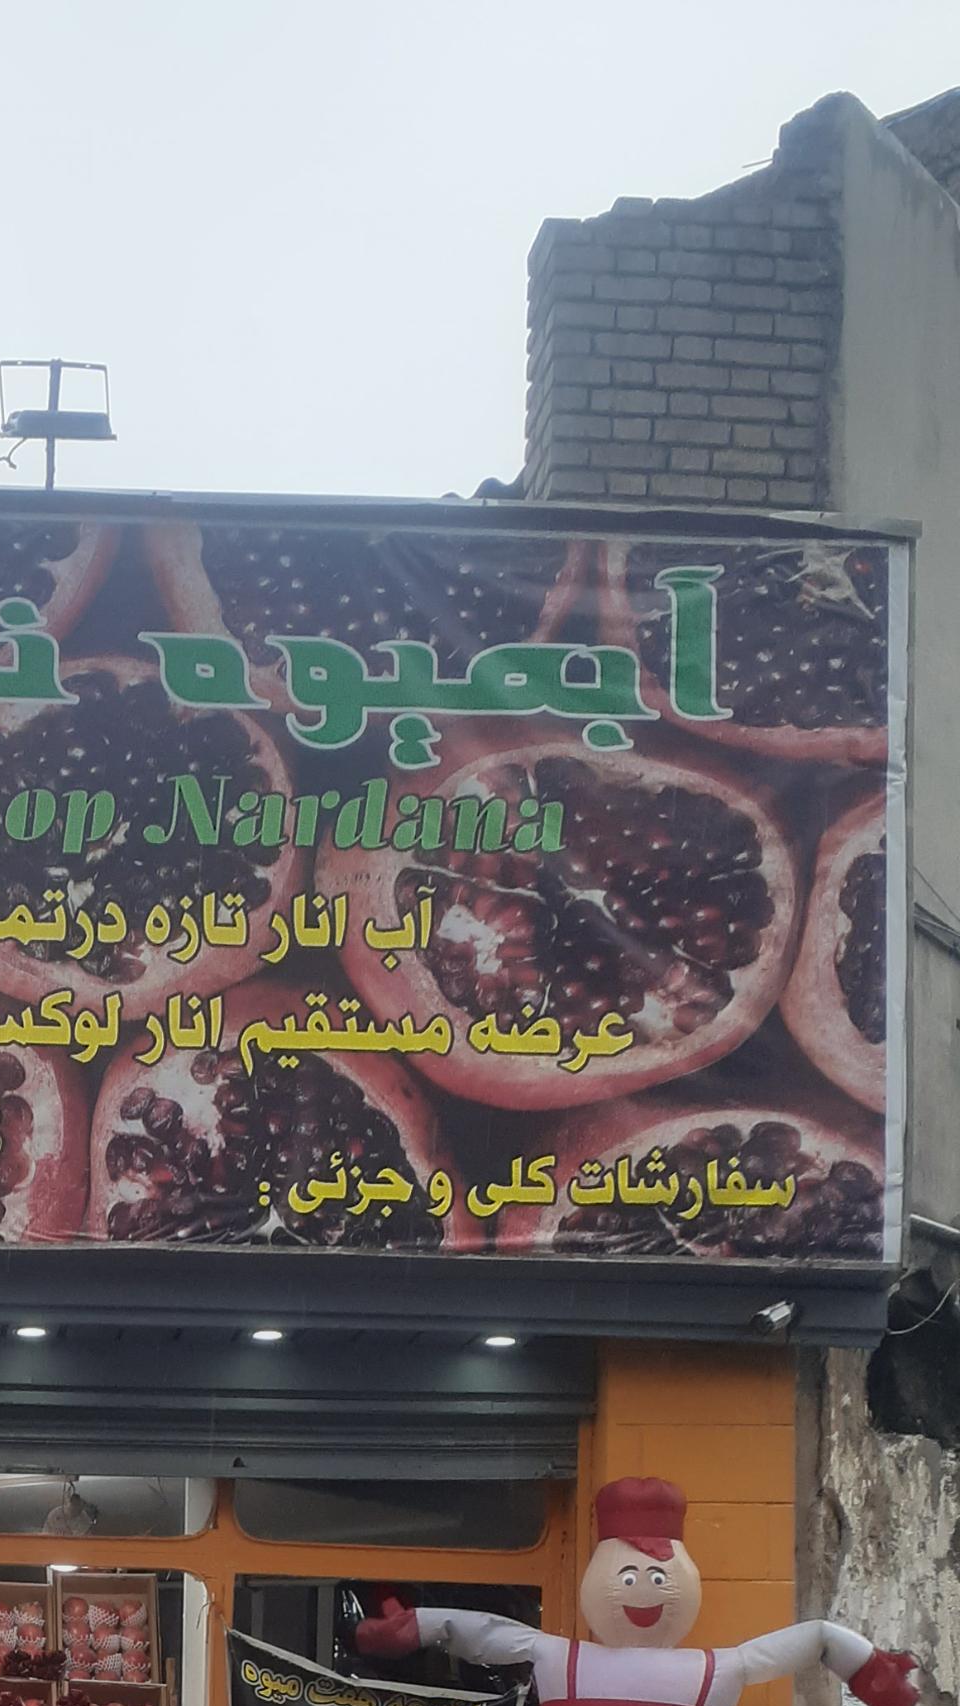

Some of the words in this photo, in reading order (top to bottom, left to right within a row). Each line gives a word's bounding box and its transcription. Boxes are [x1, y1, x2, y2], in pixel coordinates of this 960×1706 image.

[138, 564, 734, 770] آبمیوه
[145, 773, 567, 854] Nardana
[144, 891, 247, 965] تازه
[268, 891, 348, 966] انار
[369, 886, 439, 970] آب
[137, 992, 222, 1066] انار
[241, 995, 451, 1076] مستقیم
[469, 1001, 637, 1072] عرضه
[428, 1175, 453, 1218] و
[469, 1155, 558, 1213] کلی
[570, 1146, 797, 1220] سفارشات
